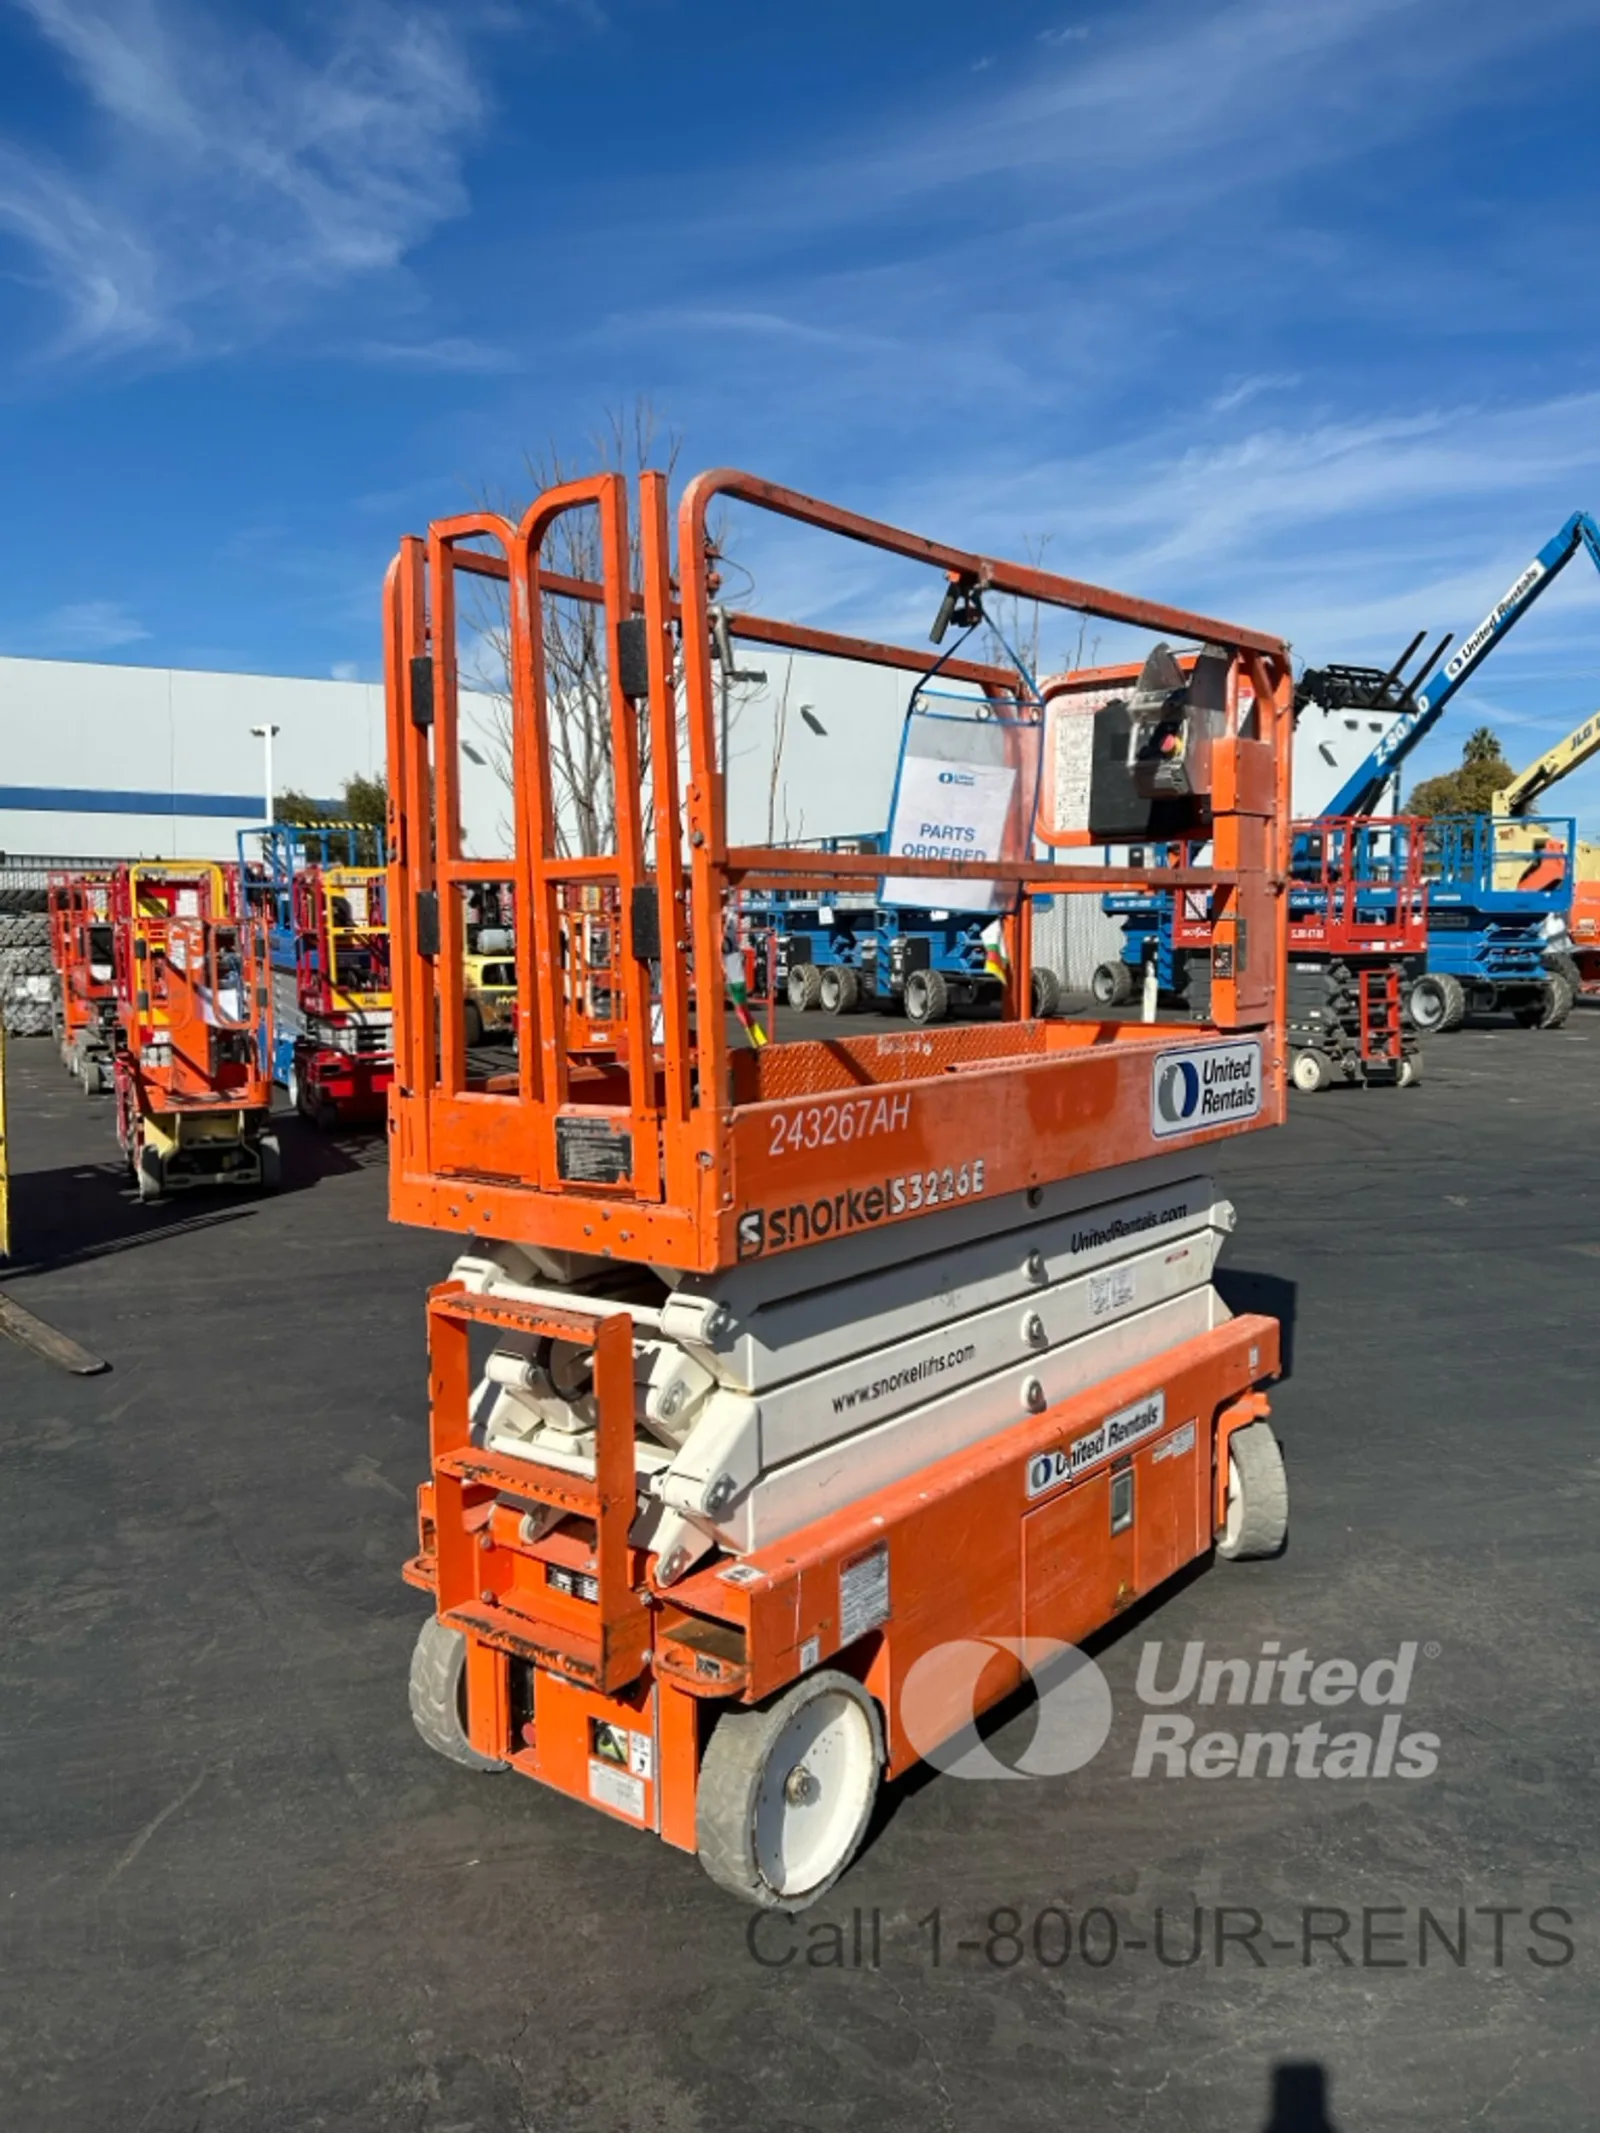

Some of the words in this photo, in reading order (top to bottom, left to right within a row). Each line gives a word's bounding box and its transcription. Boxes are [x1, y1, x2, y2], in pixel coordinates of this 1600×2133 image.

[1462, 613, 1497, 660] United
[1497, 568, 1539, 620] Rentals
[919, 822, 977, 843] PARTS
[1202, 1053, 1253, 1086] United
[1201, 1082, 1256, 1116] Rentals
[768, 1093, 911, 1156] 243267AH
[768, 1178, 893, 1249] snorkel
[890, 1160, 985, 1215] S3226E
[1071, 1204, 1188, 1254] UnitedRentals.com
[832, 1343, 976, 1414] www.snorkellifts.com
[1107, 1403, 1159, 1448] Rentals
